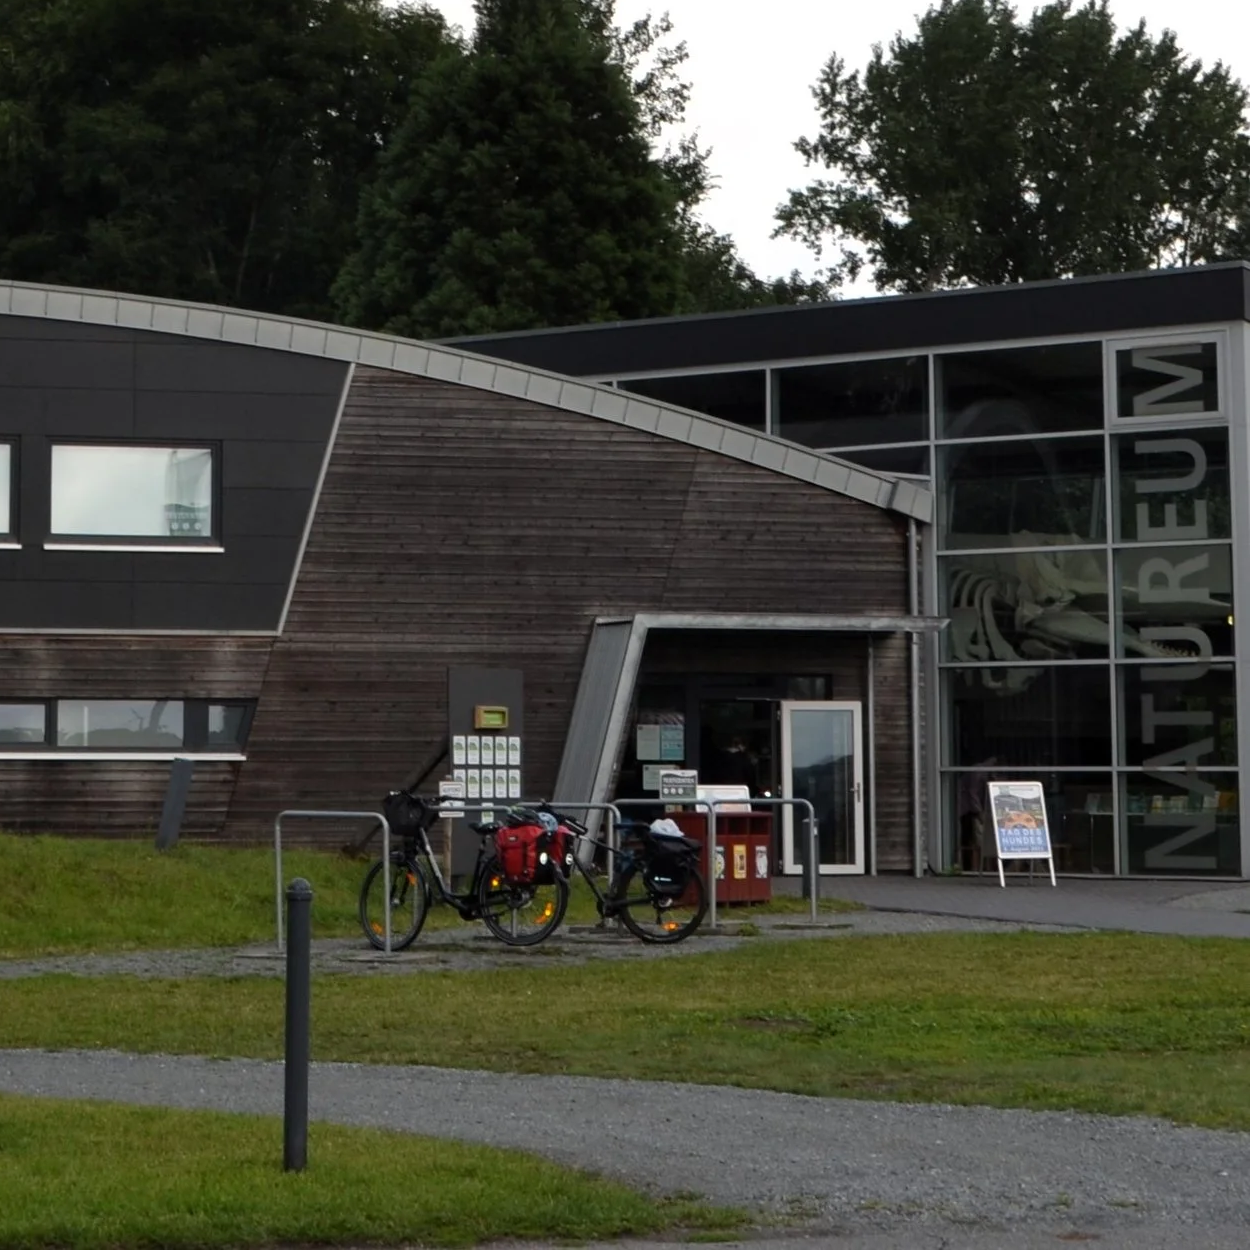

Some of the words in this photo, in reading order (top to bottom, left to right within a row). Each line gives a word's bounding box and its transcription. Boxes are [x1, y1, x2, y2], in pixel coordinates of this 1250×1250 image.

[1130, 342, 1217, 870] NATUREUM
[1000, 828, 1020, 836] TAG
[1022, 828, 1042, 836] DES
[1001, 836, 1043, 845] HUNDES
